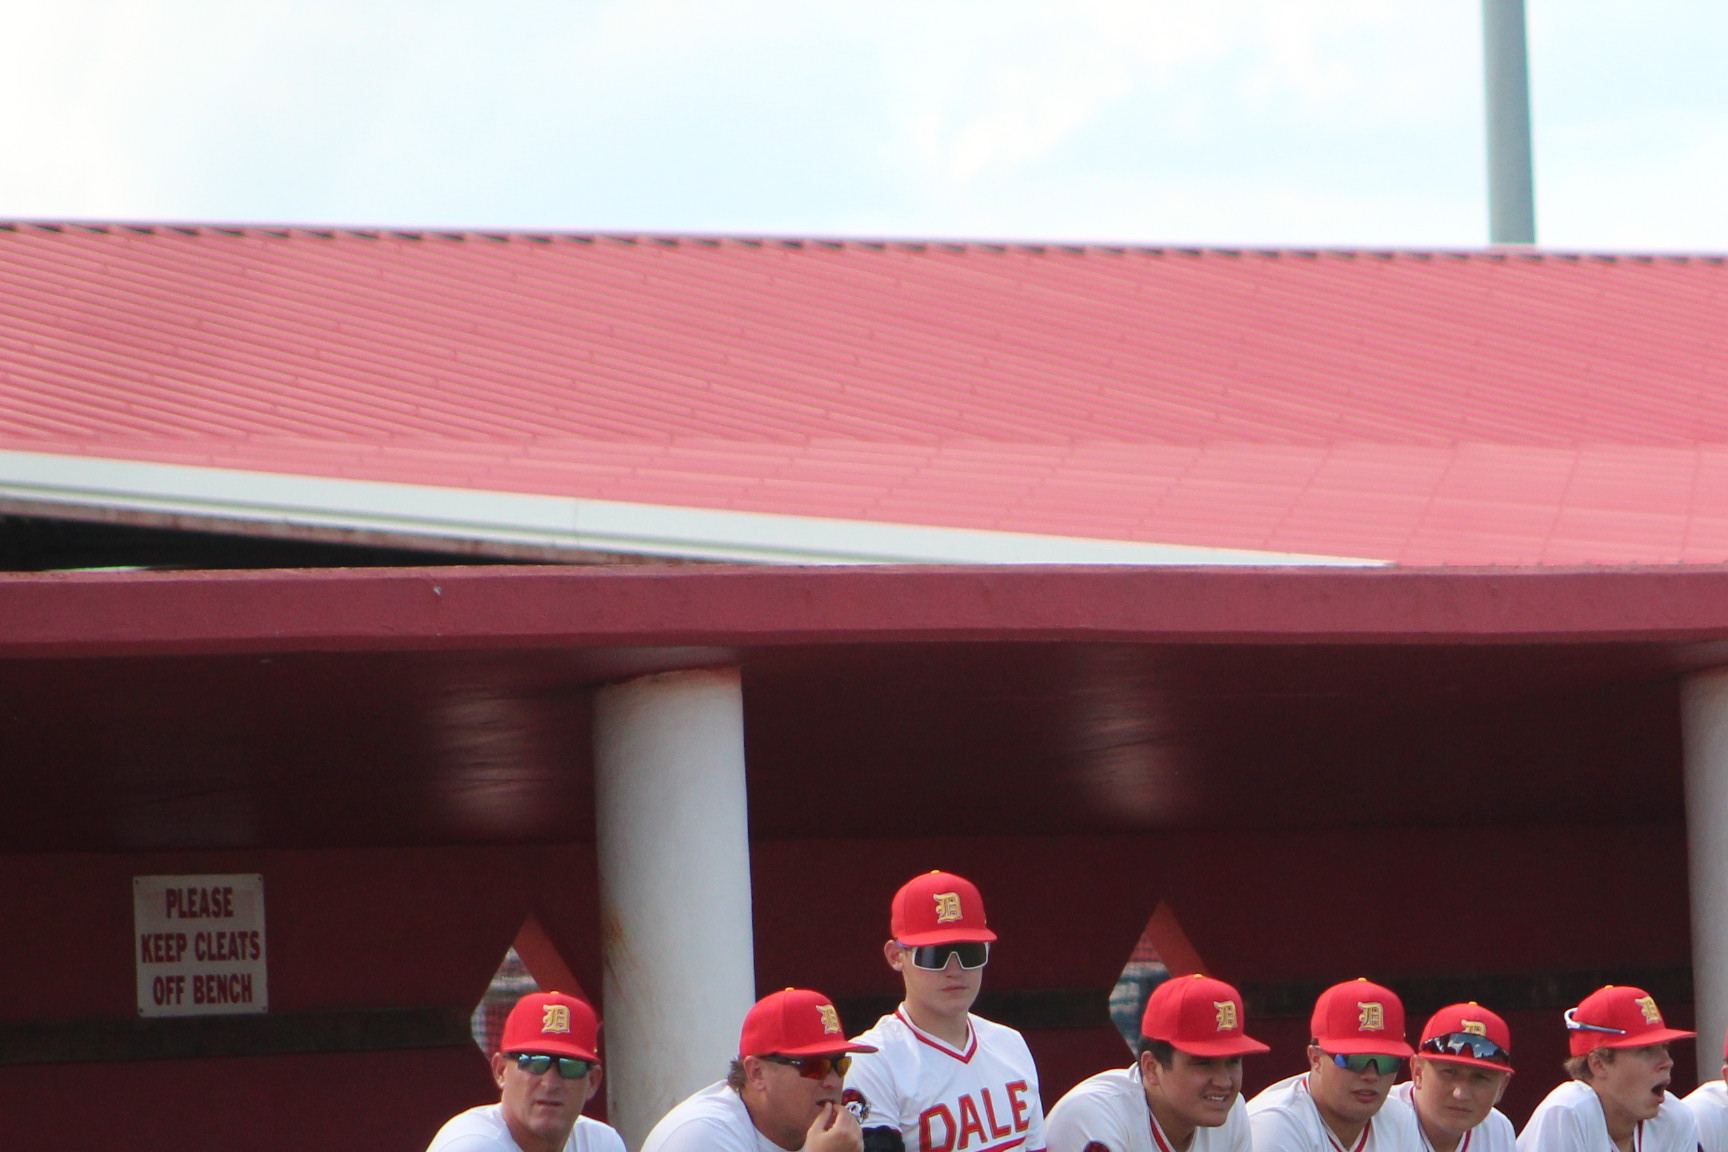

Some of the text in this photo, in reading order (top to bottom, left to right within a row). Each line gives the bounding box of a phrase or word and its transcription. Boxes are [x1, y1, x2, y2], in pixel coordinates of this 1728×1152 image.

[165, 887, 234, 919] PLEASE
[933, 891, 963, 924] D
[141, 930, 261, 964] KEEP CLEATS
[152, 973, 253, 1006] OFF BENCH
[541, 1004, 571, 1034] D
[816, 1004, 842, 1034] D
[1213, 1000, 1238, 1031] D
[1357, 1001, 1385, 1032] D
